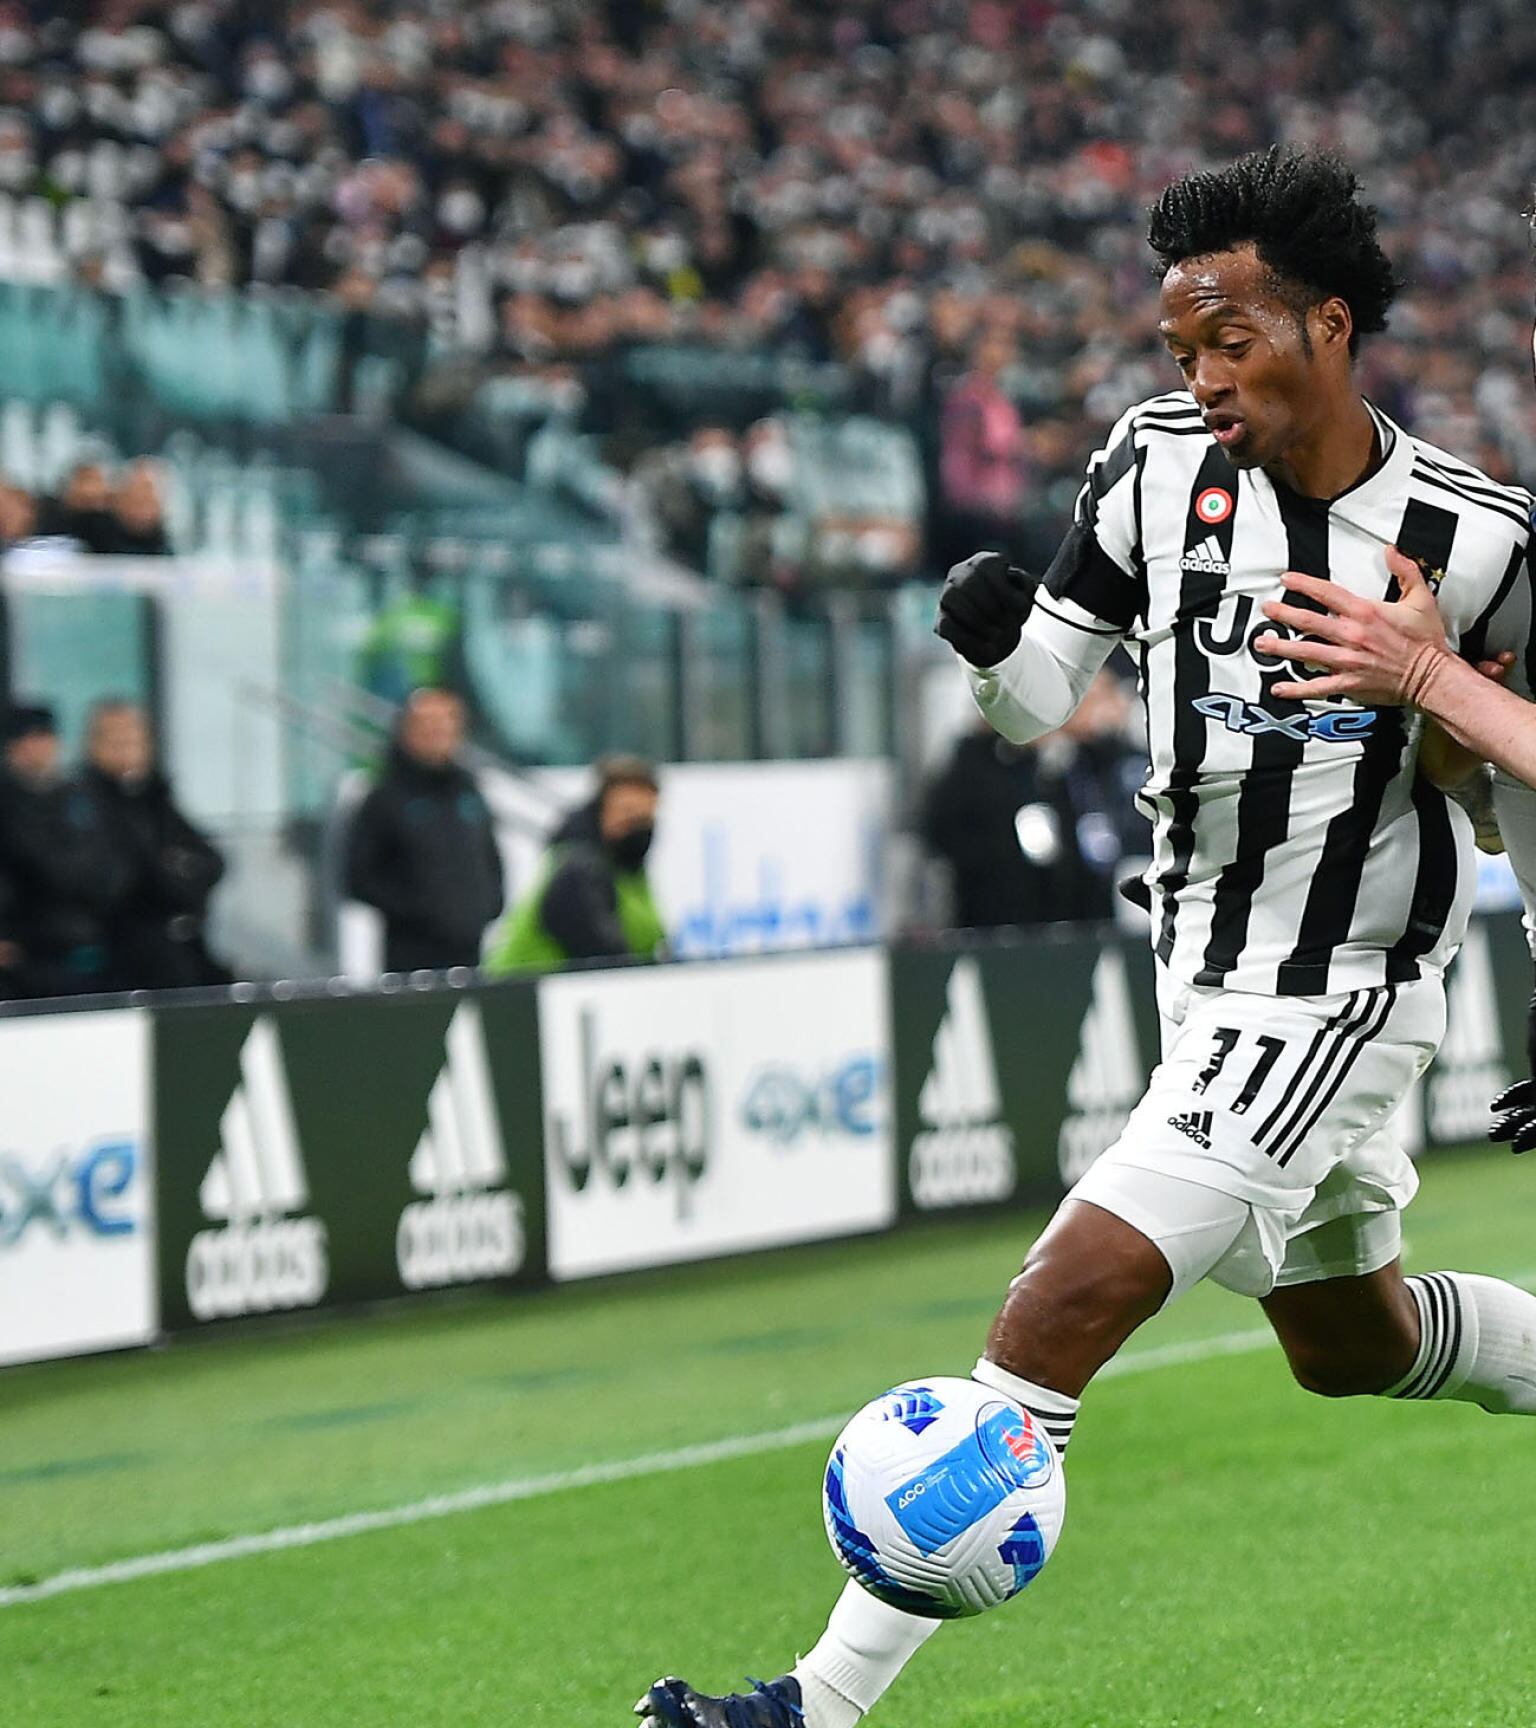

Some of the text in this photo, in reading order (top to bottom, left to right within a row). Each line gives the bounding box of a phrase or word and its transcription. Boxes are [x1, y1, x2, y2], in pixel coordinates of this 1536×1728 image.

[1179, 557, 1230, 575] adidas
[1191, 694, 1377, 741] 4xe
[1192, 1026, 1287, 1115] 11
[553, 1006, 711, 1222] Jeep
[1167, 1116, 1213, 1150] adidas
[0, 1142, 137, 1246] xe
